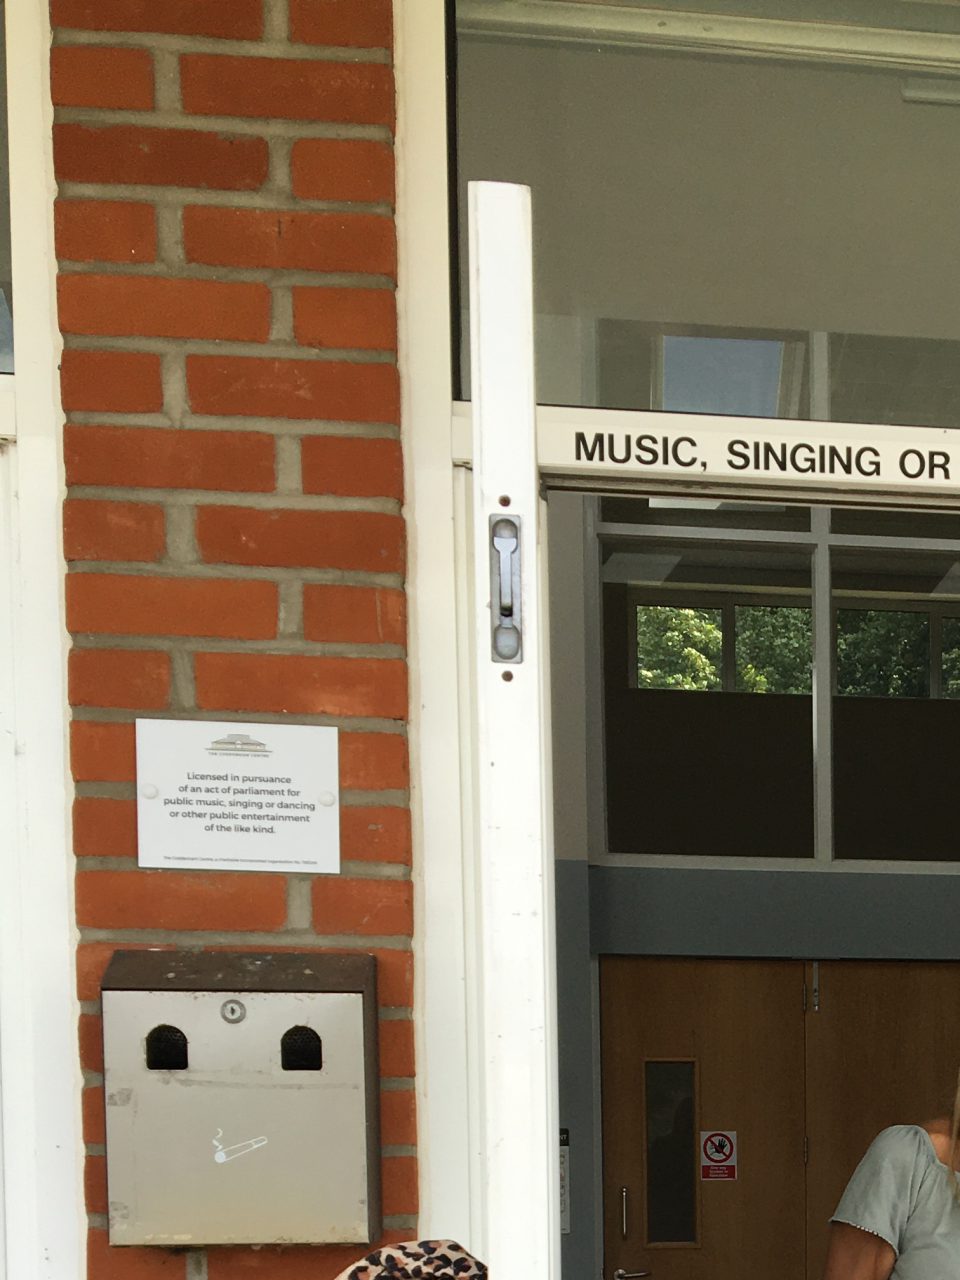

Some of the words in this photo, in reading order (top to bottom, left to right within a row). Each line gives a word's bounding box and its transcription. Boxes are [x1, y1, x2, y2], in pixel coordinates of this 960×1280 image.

[575, 431, 707, 472] MUSIC,
[726, 439, 881, 476] SINGING
[899, 449, 950, 480] OR
[187, 772, 228, 782] Licensed
[230, 772, 239, 781] in
[242, 775, 291, 784] pursuance
[178, 784, 188, 793] of
[204, 786, 218, 794] act
[221, 785, 231, 794] of
[233, 786, 284, 797] parliament
[287, 787, 301, 797] for
[163, 797, 193, 806] public
[196, 798, 227, 808] music,
[228, 800, 263, 809] singing
[277, 801, 315, 811] dancing
[181, 810, 207, 819] other
[209, 811, 239, 821] public
[241, 813, 310, 822] entertainment
[204, 823, 214, 832] of
[216, 824, 232, 833] the
[234, 824, 250, 833] like
[252, 825, 276, 834] kind.
